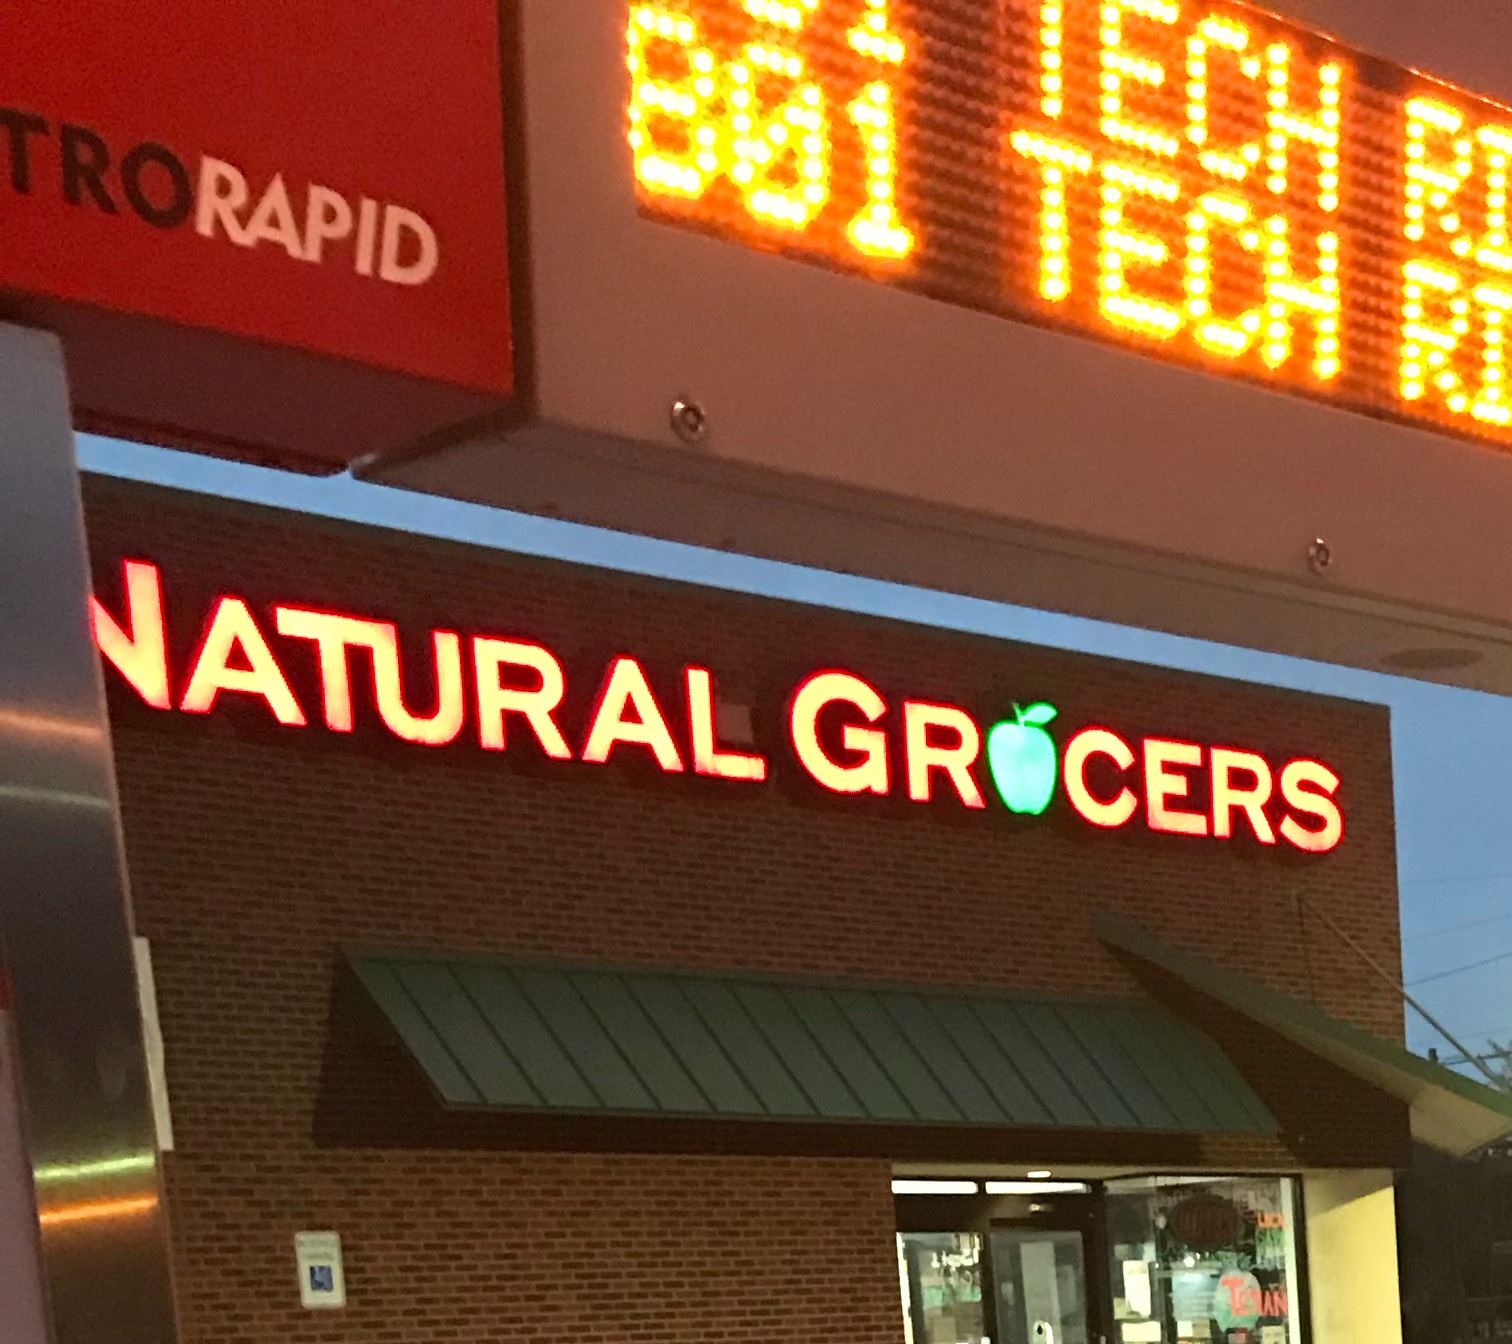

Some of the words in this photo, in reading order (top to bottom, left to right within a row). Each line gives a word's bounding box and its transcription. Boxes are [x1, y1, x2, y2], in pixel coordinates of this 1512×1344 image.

[627, 5, 915, 258] 801
[1009, 127, 1343, 386] TECH
[87, 557, 769, 782] NATURAL
